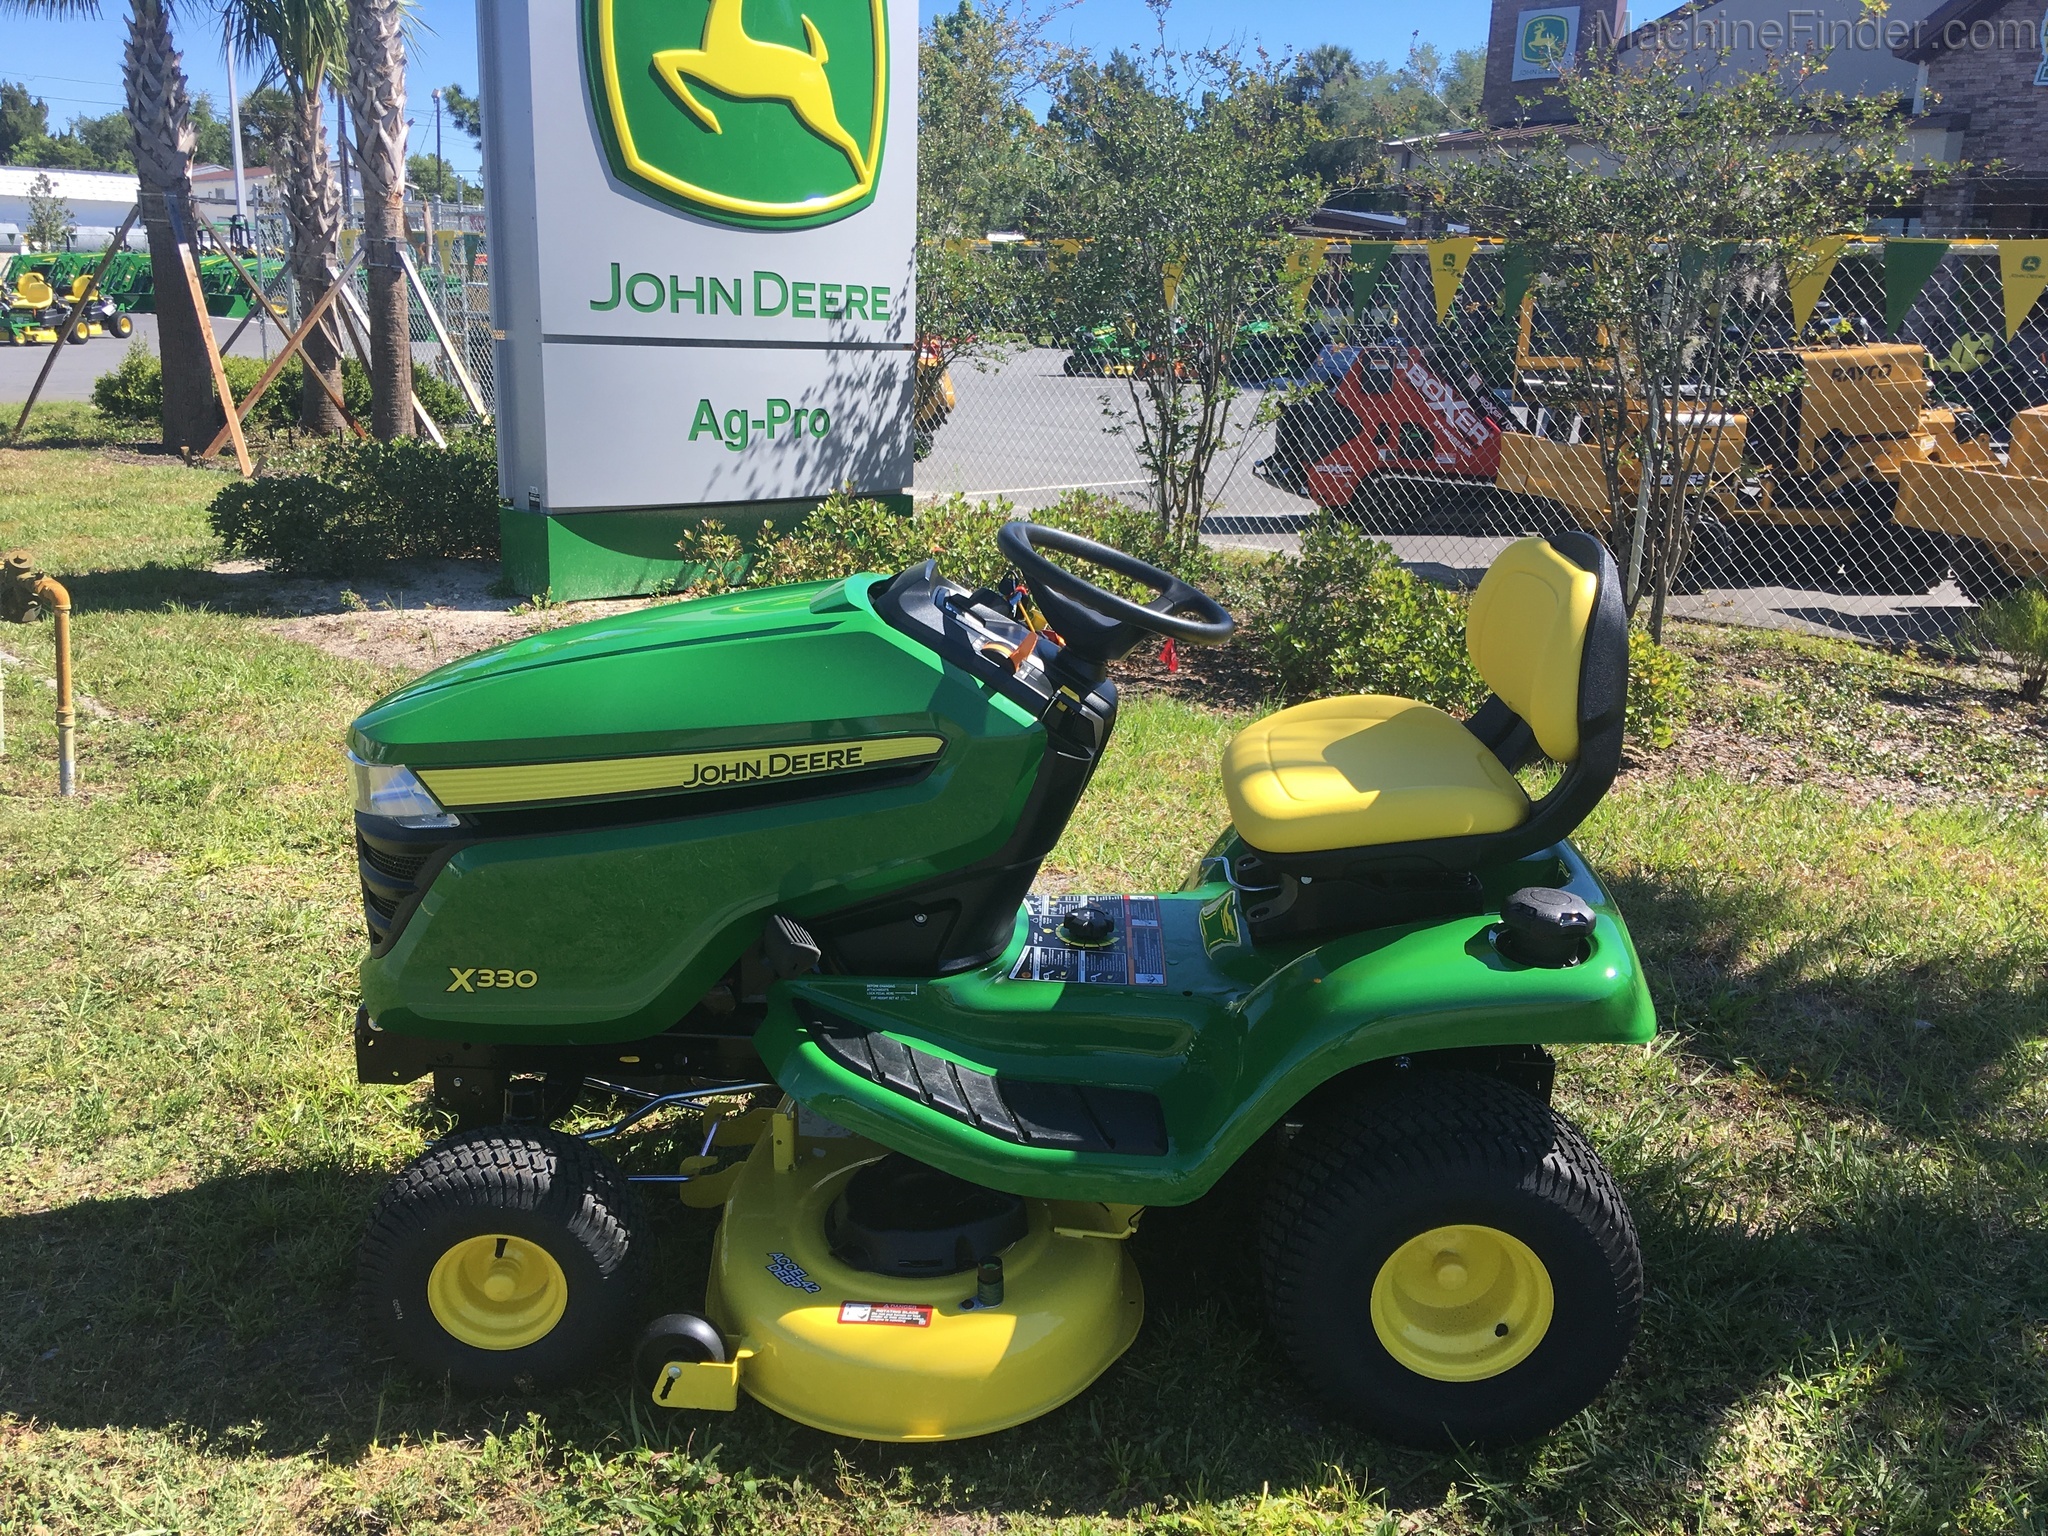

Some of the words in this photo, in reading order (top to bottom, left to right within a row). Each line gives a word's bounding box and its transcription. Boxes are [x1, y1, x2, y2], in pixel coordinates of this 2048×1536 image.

[590, 262, 742, 317] JOHN
[753, 270, 891, 321] DEERE
[1831, 364, 1893, 383] RAYCO
[1406, 363, 1489, 446] BOXER
[1479, 396, 1503, 420] BOXER
[687, 398, 831, 452] Ag-Pro
[683, 760, 762, 787] JOHN
[769, 746, 863, 777] DEERE
[445, 967, 538, 993] X330
[766, 1264, 802, 1287] DEEP
